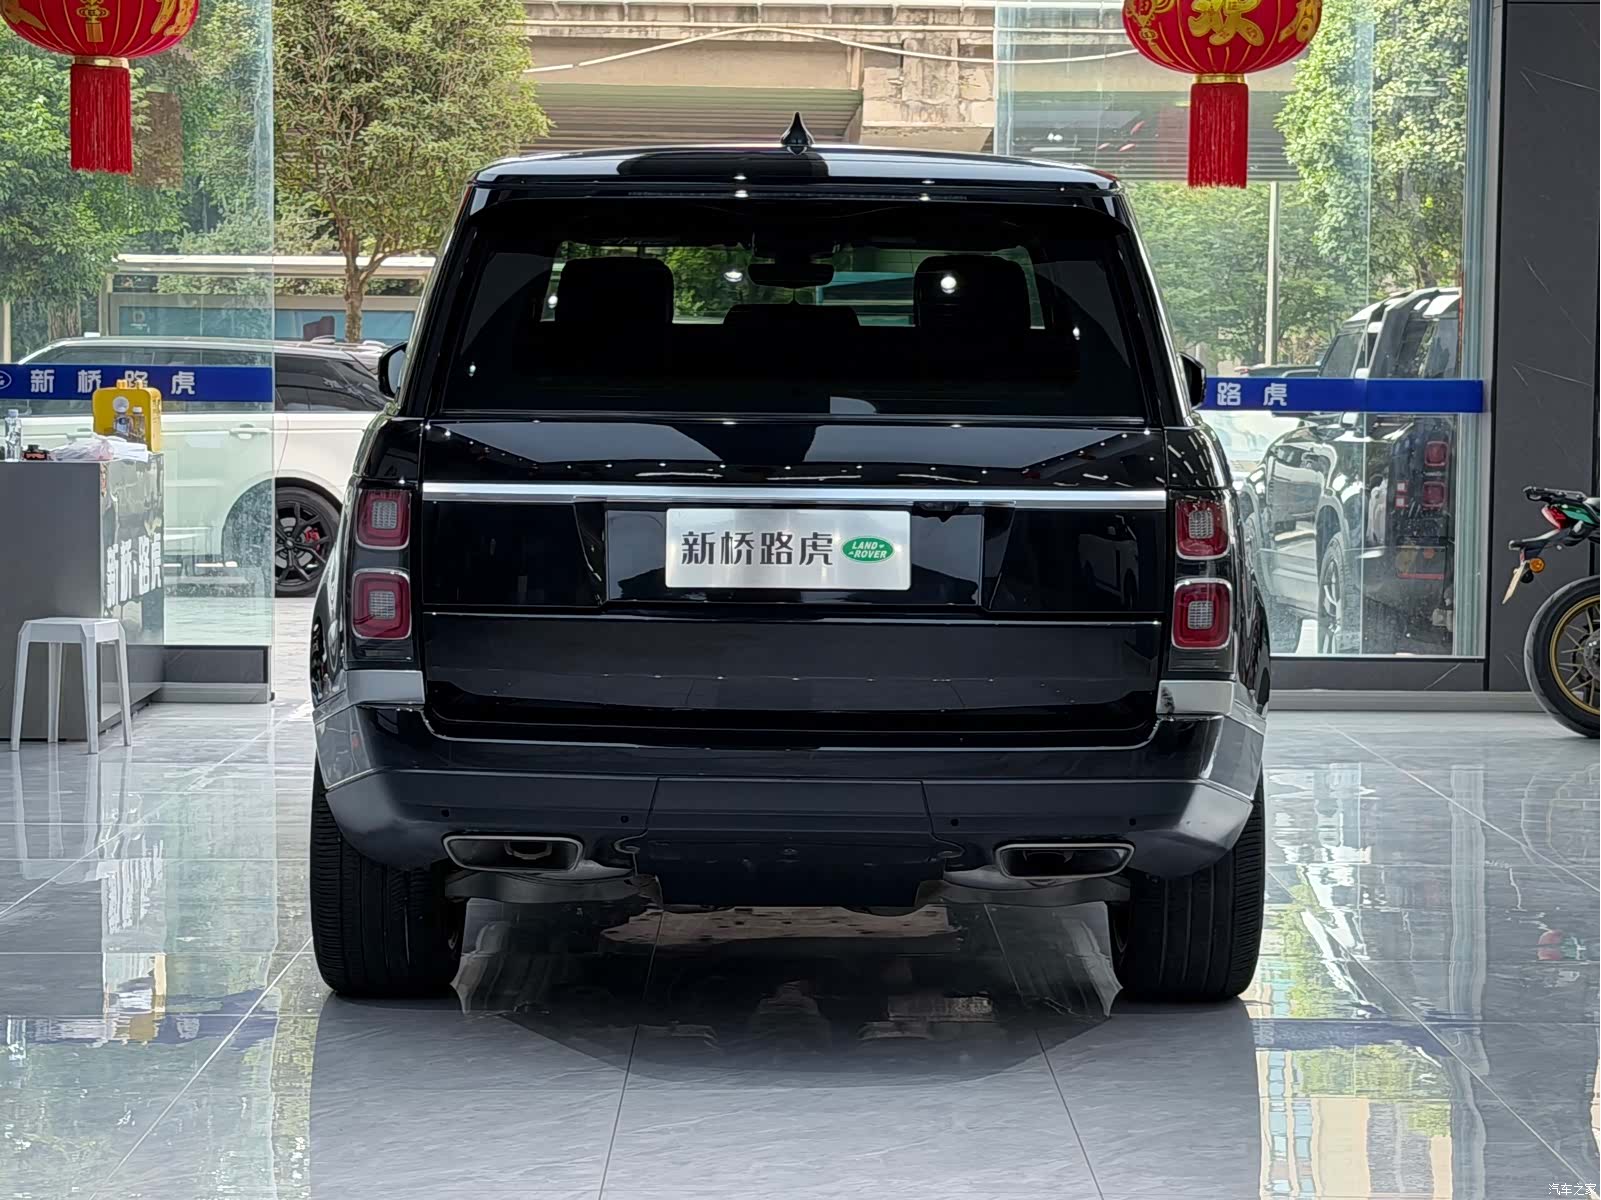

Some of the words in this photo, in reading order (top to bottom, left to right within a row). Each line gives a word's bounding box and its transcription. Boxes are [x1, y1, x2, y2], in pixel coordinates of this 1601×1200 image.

[1216, 382, 1288, 407] 路虎
[681, 531, 834, 566] 新桥路虎
[851, 541, 878, 550] LAND
[853, 550, 888, 559] ROVER
